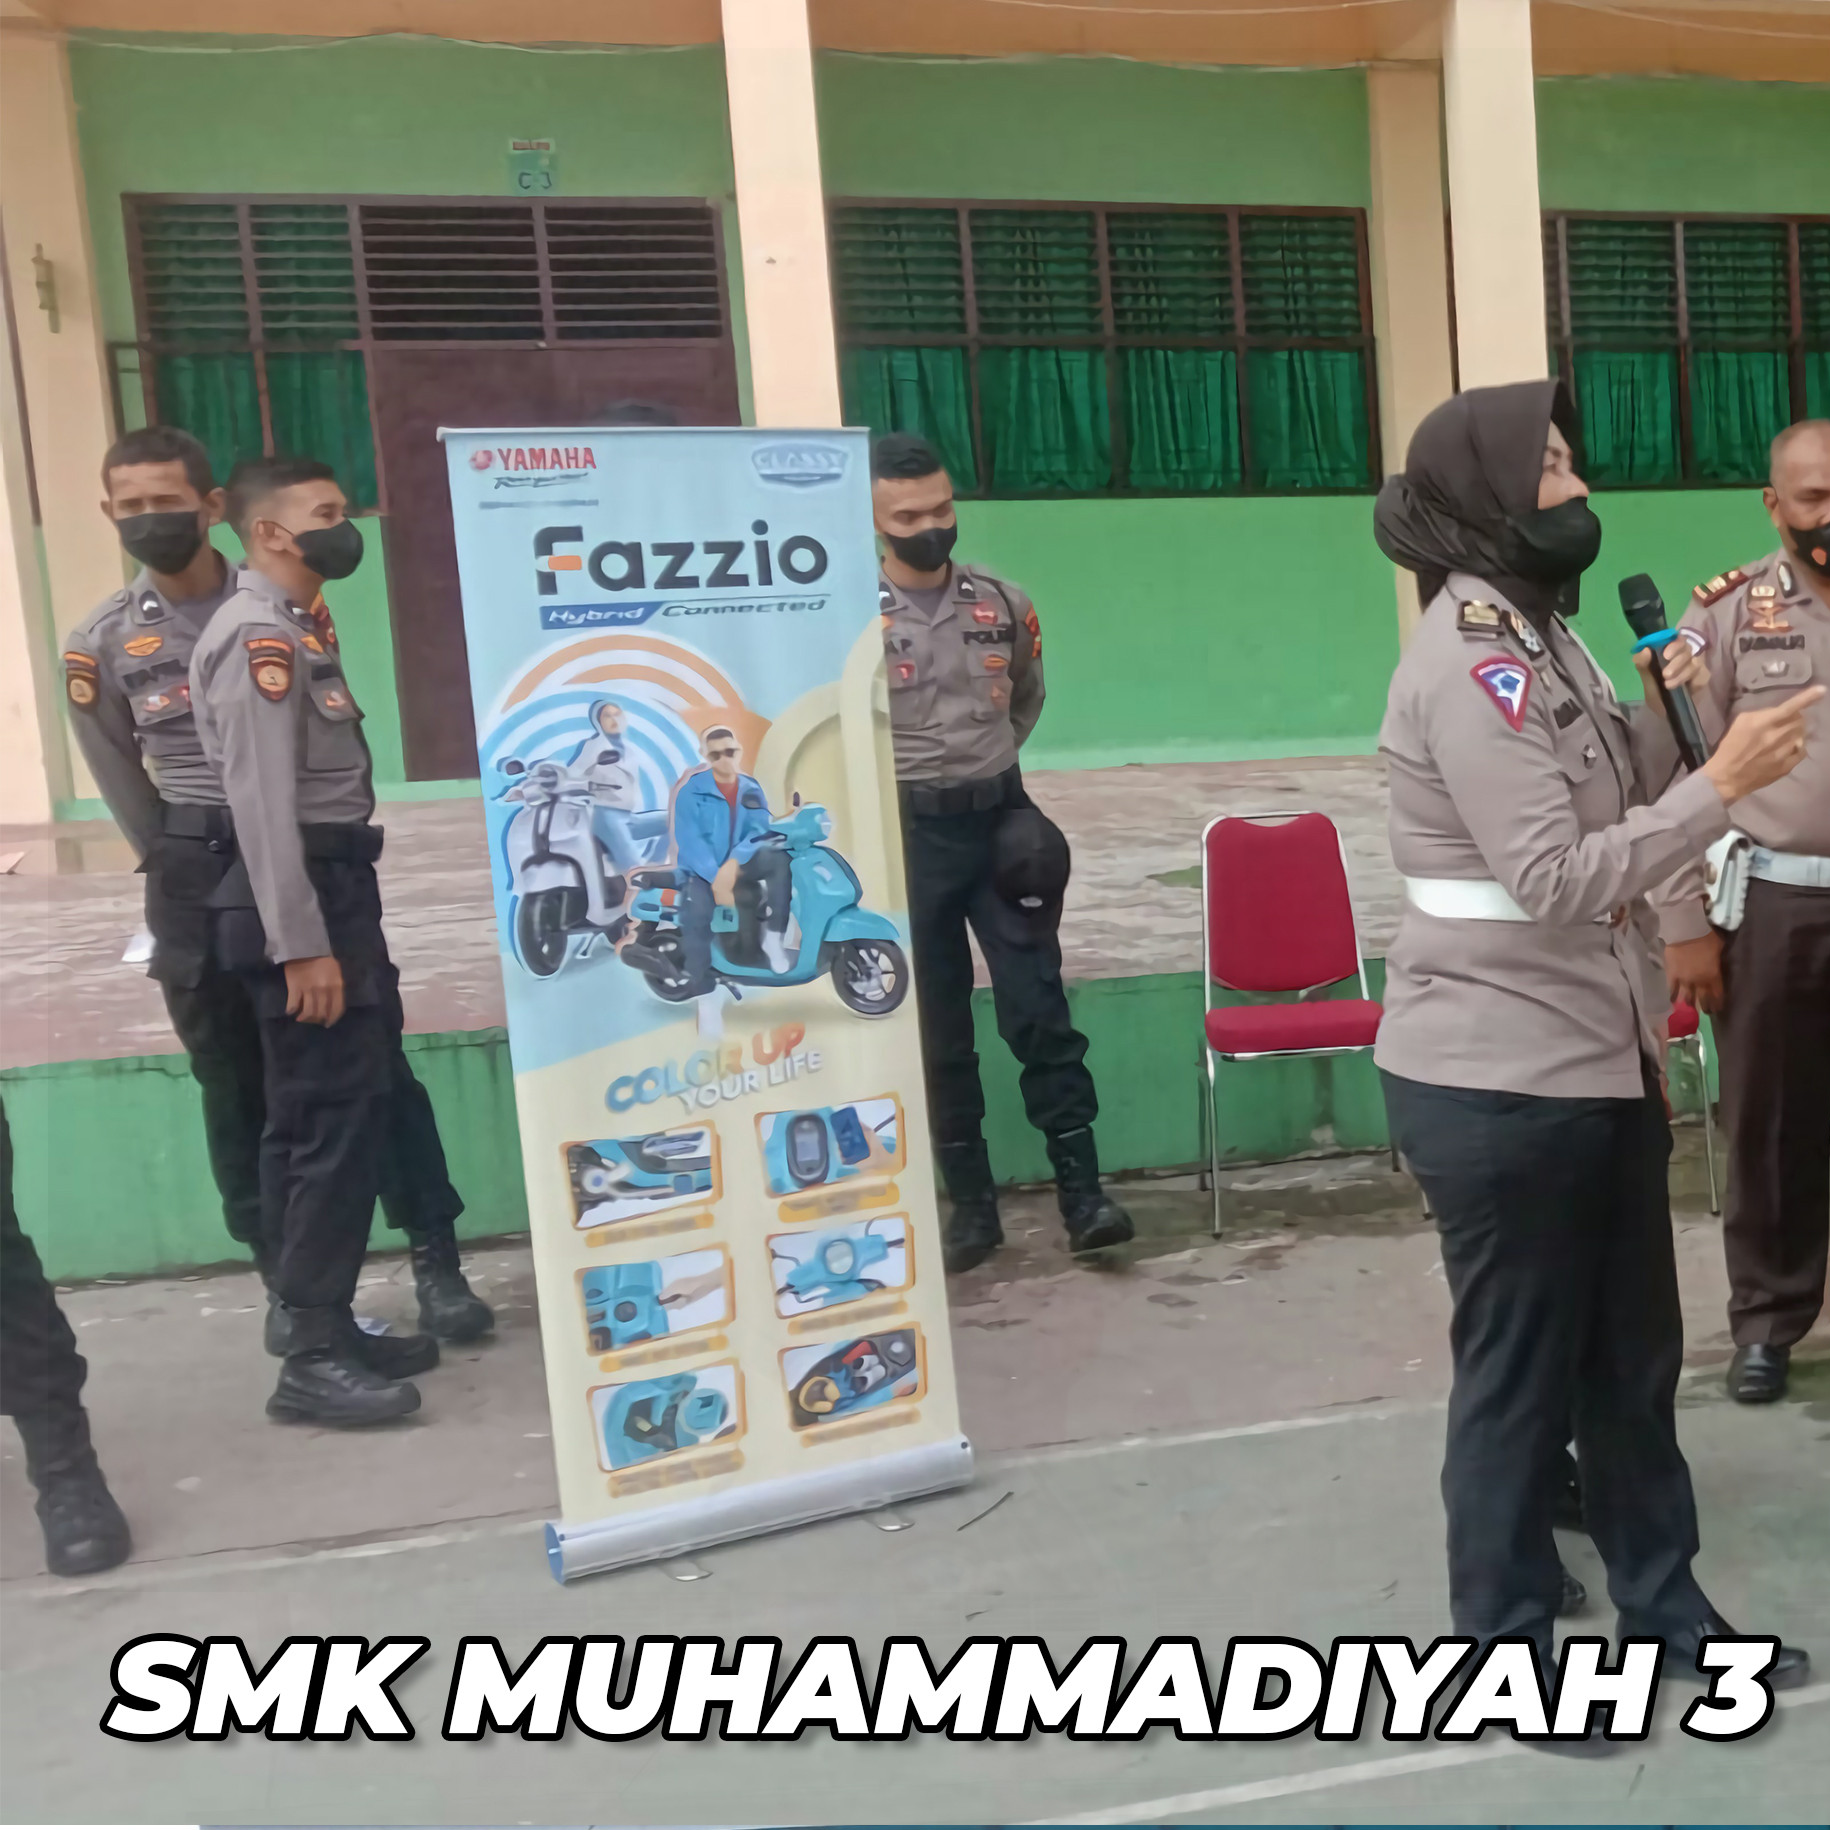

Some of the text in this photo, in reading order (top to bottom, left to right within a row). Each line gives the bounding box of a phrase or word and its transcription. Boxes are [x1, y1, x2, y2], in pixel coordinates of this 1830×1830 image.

[497, 447, 597, 471] YAMAHA
[533, 519, 828, 595] Fazzio
[549, 606, 645, 625] Hybrid
[605, 1022, 806, 1113] COLOR UP
[676, 1050, 823, 1115] YOUR LIFE
